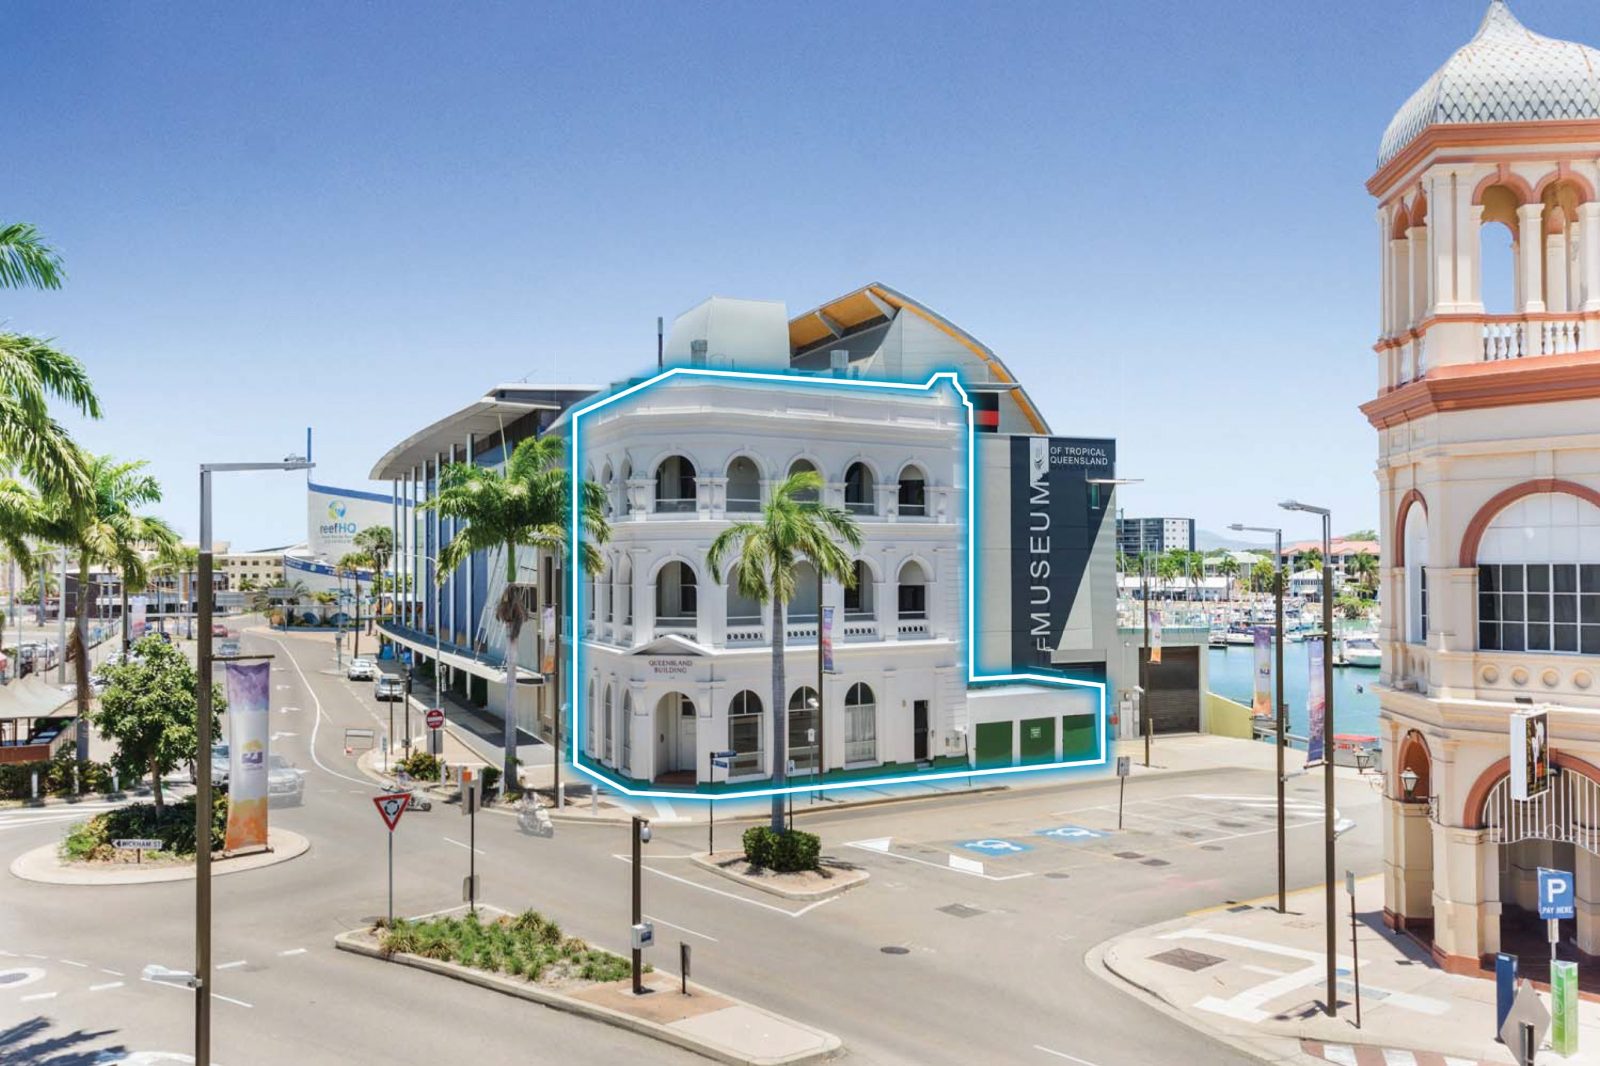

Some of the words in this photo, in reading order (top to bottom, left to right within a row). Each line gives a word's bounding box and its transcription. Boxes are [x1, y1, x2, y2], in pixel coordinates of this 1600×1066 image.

[1050, 446, 1062, 455] OF
[1065, 447, 1106, 457] TROPICAL
[1050, 456, 1108, 466] QUEENSLAND
[1030, 481, 1051, 635] MUSEUM
[1547, 878, 1567, 903] P
